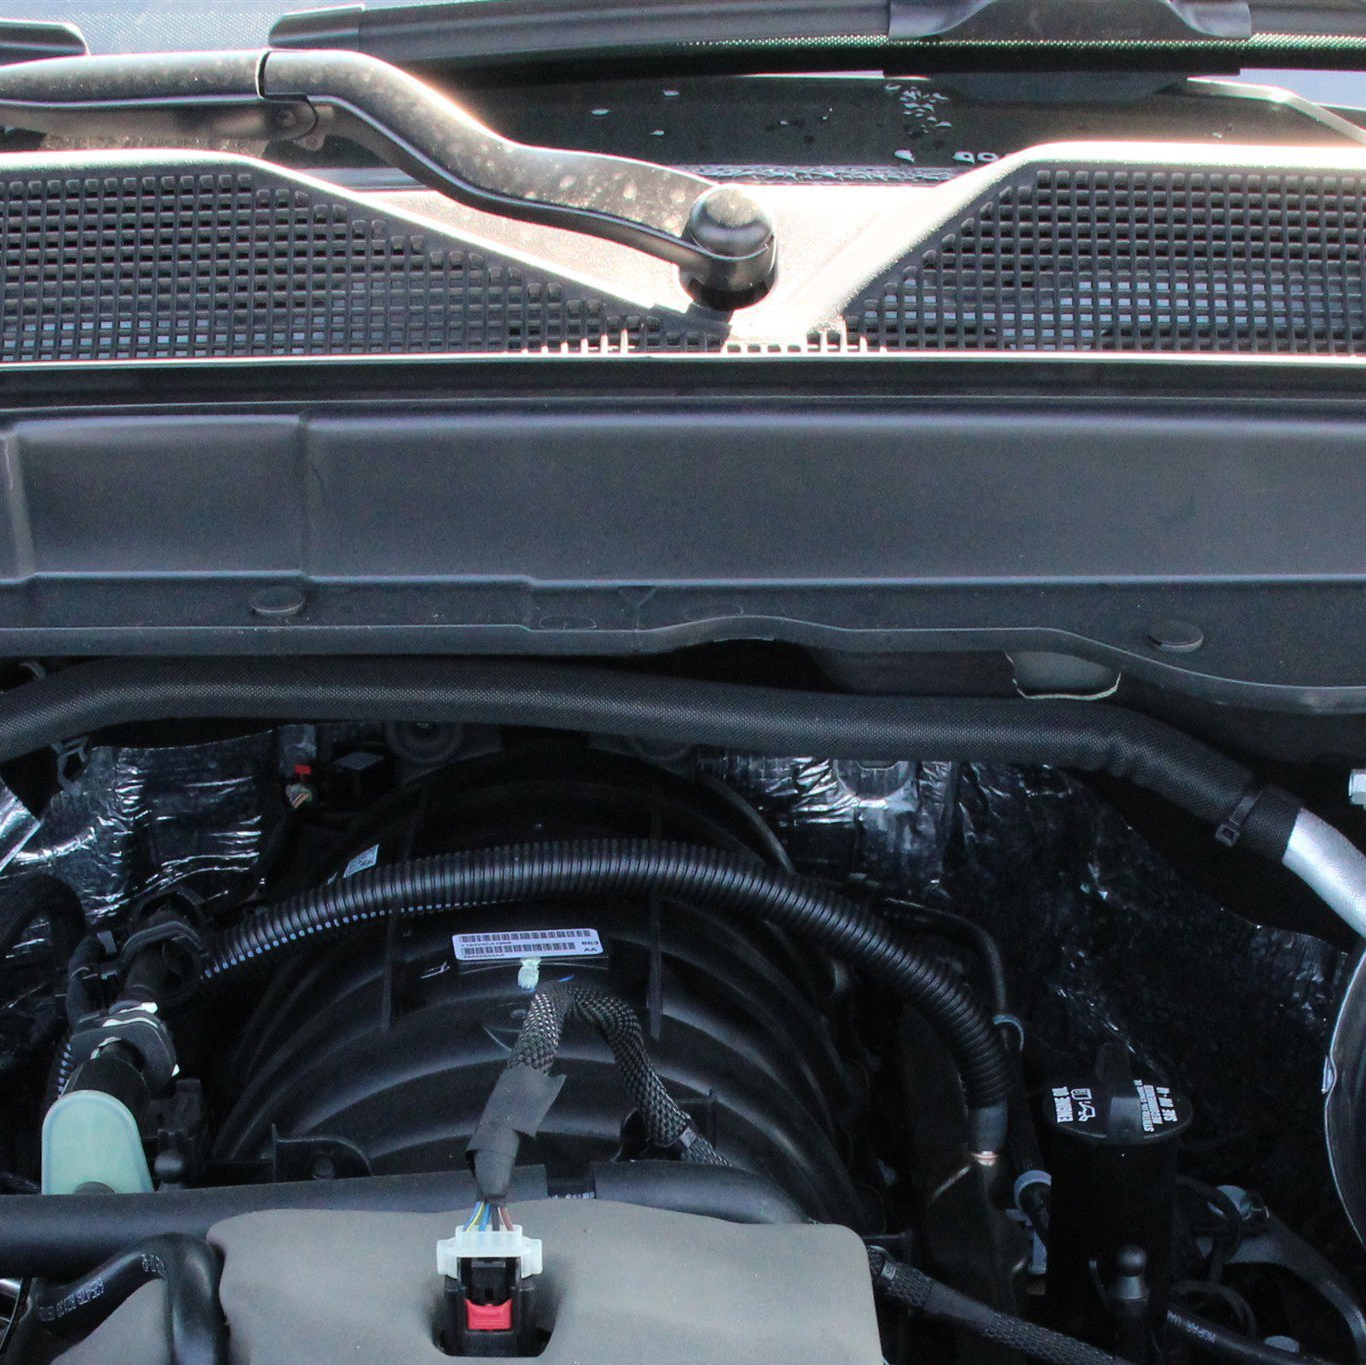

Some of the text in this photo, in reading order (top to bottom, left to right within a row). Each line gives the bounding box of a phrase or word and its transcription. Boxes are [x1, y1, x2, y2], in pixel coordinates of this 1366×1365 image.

[1052, 1086, 1073, 1123] ENGINE OIL
[1161, 1108, 1178, 1122] SAE
